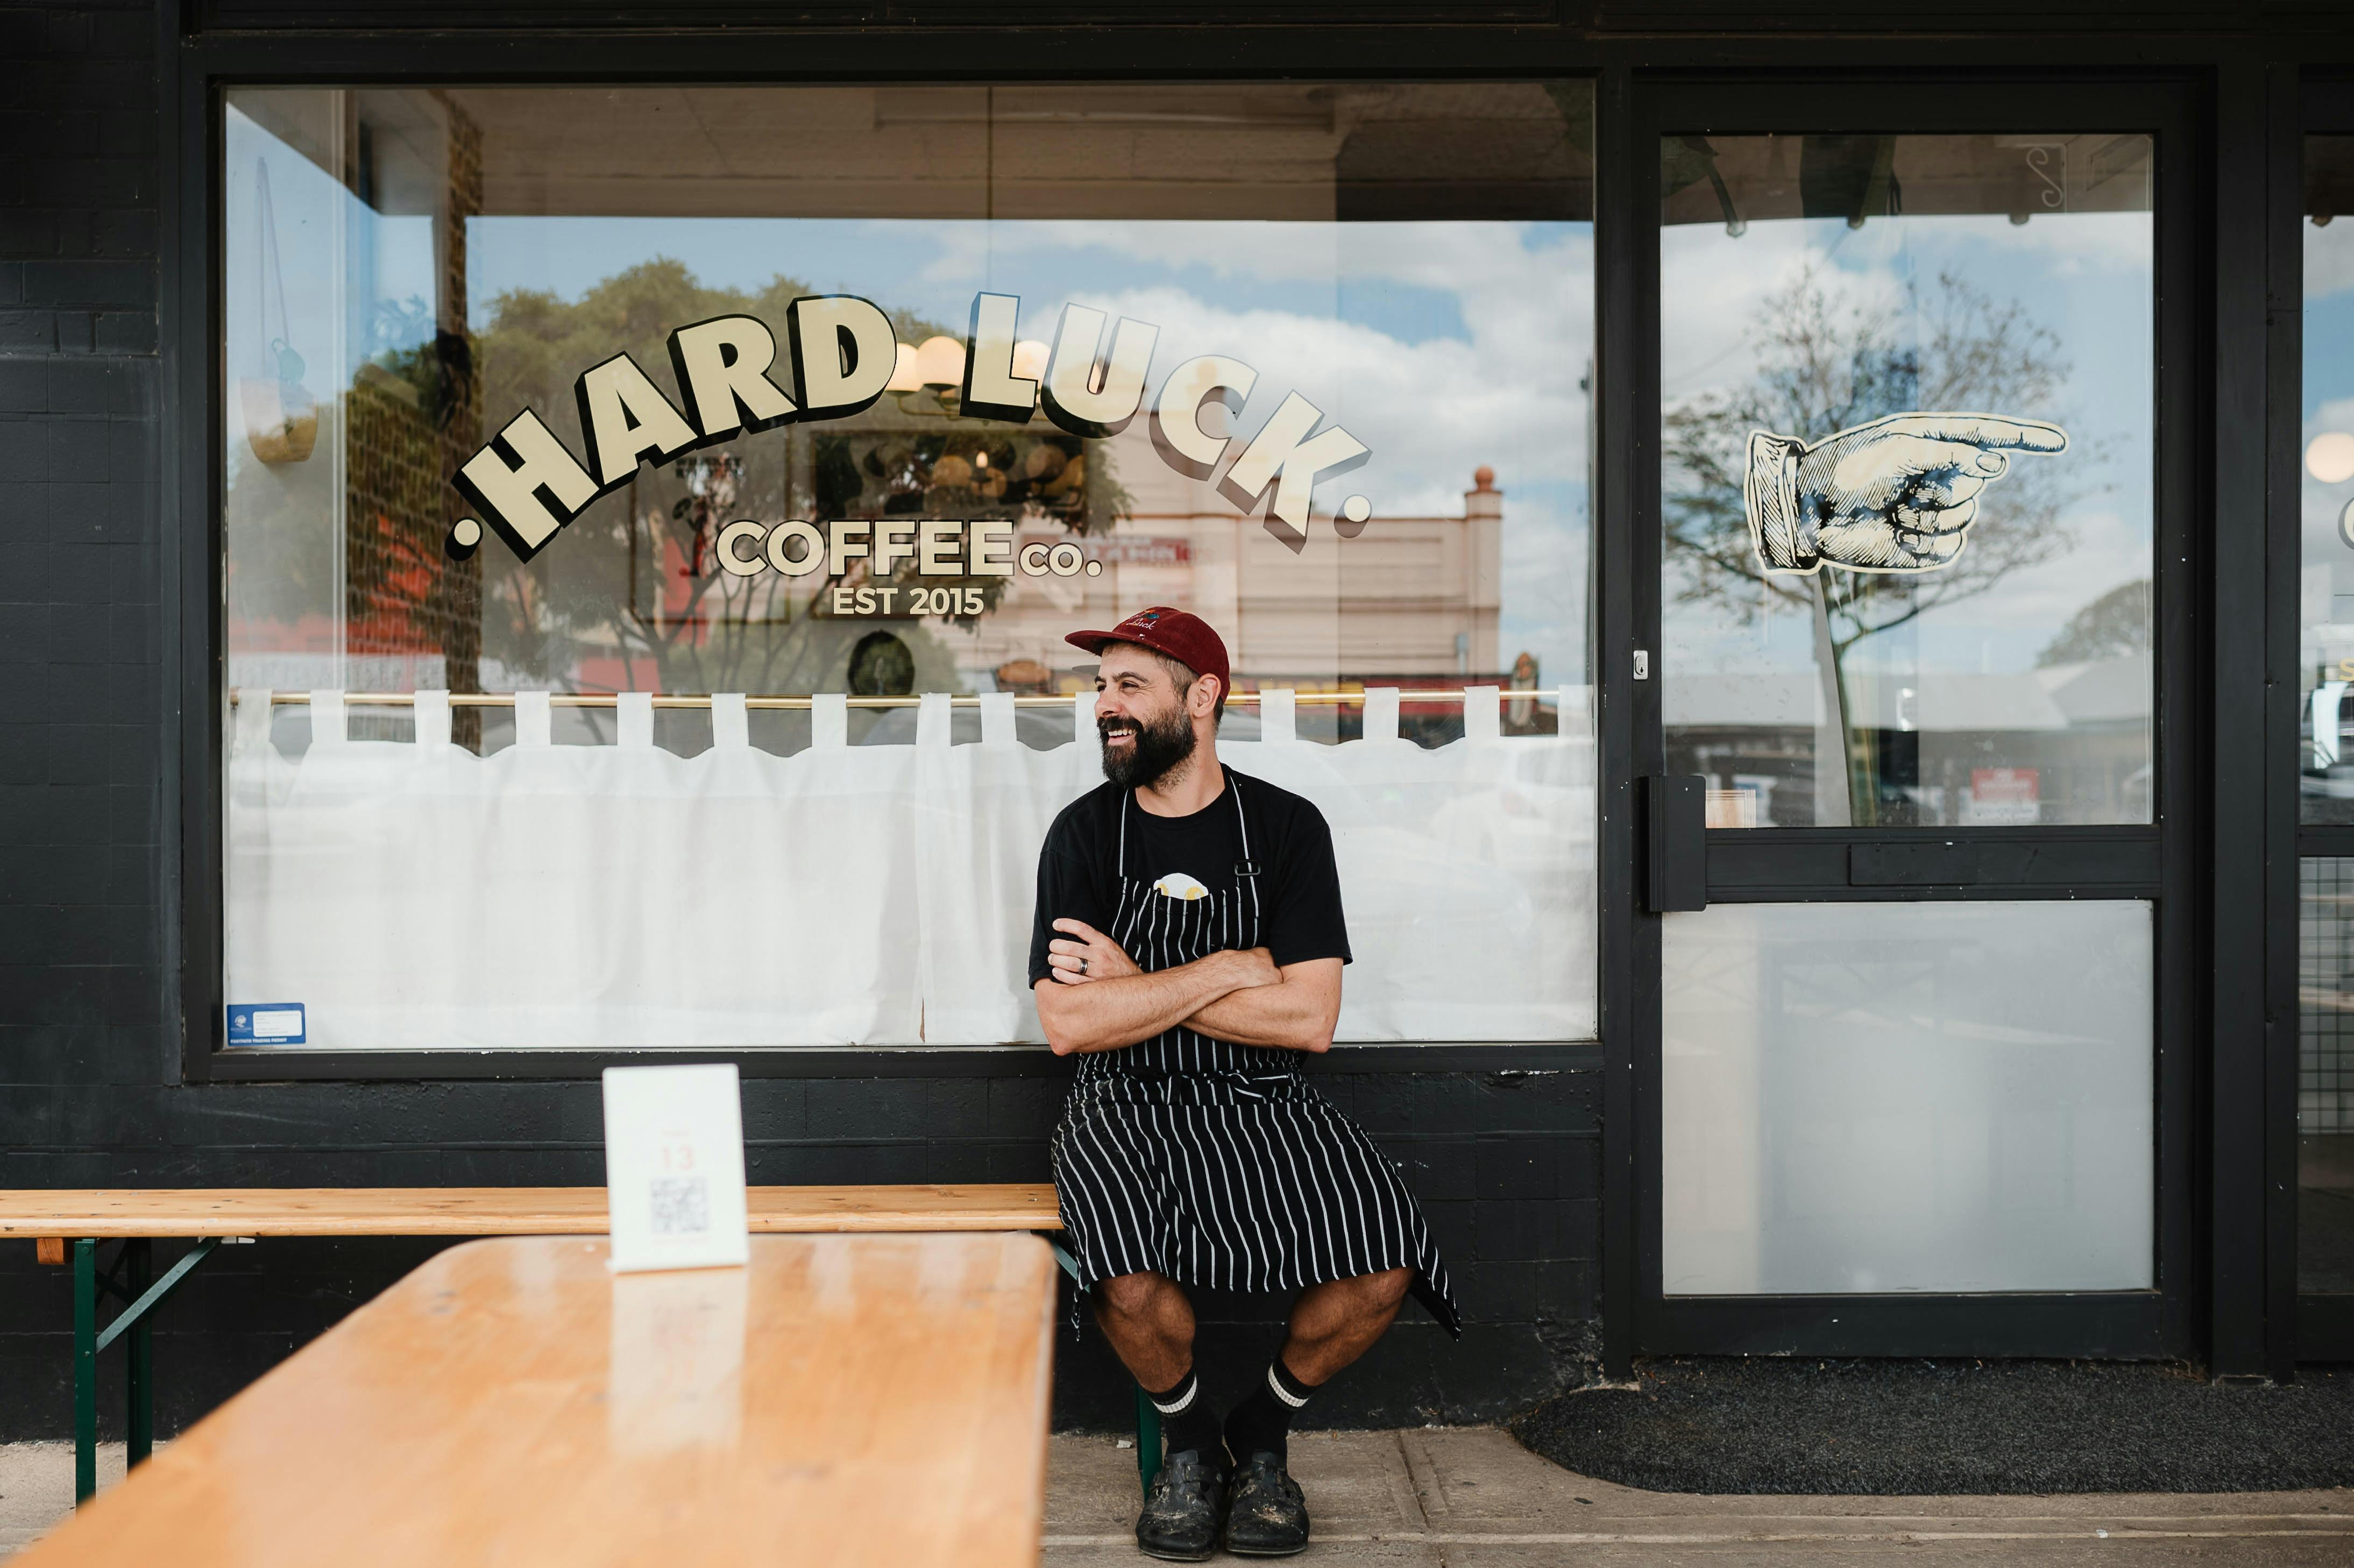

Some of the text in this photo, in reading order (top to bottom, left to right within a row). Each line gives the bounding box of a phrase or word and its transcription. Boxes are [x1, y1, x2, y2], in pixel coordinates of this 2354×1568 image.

[715, 519, 1015, 577] COFFEE
[833, 587, 984, 615] EST 2015
[1126, 618, 1157, 630] Luck
[661, 1145, 696, 1170] 13
